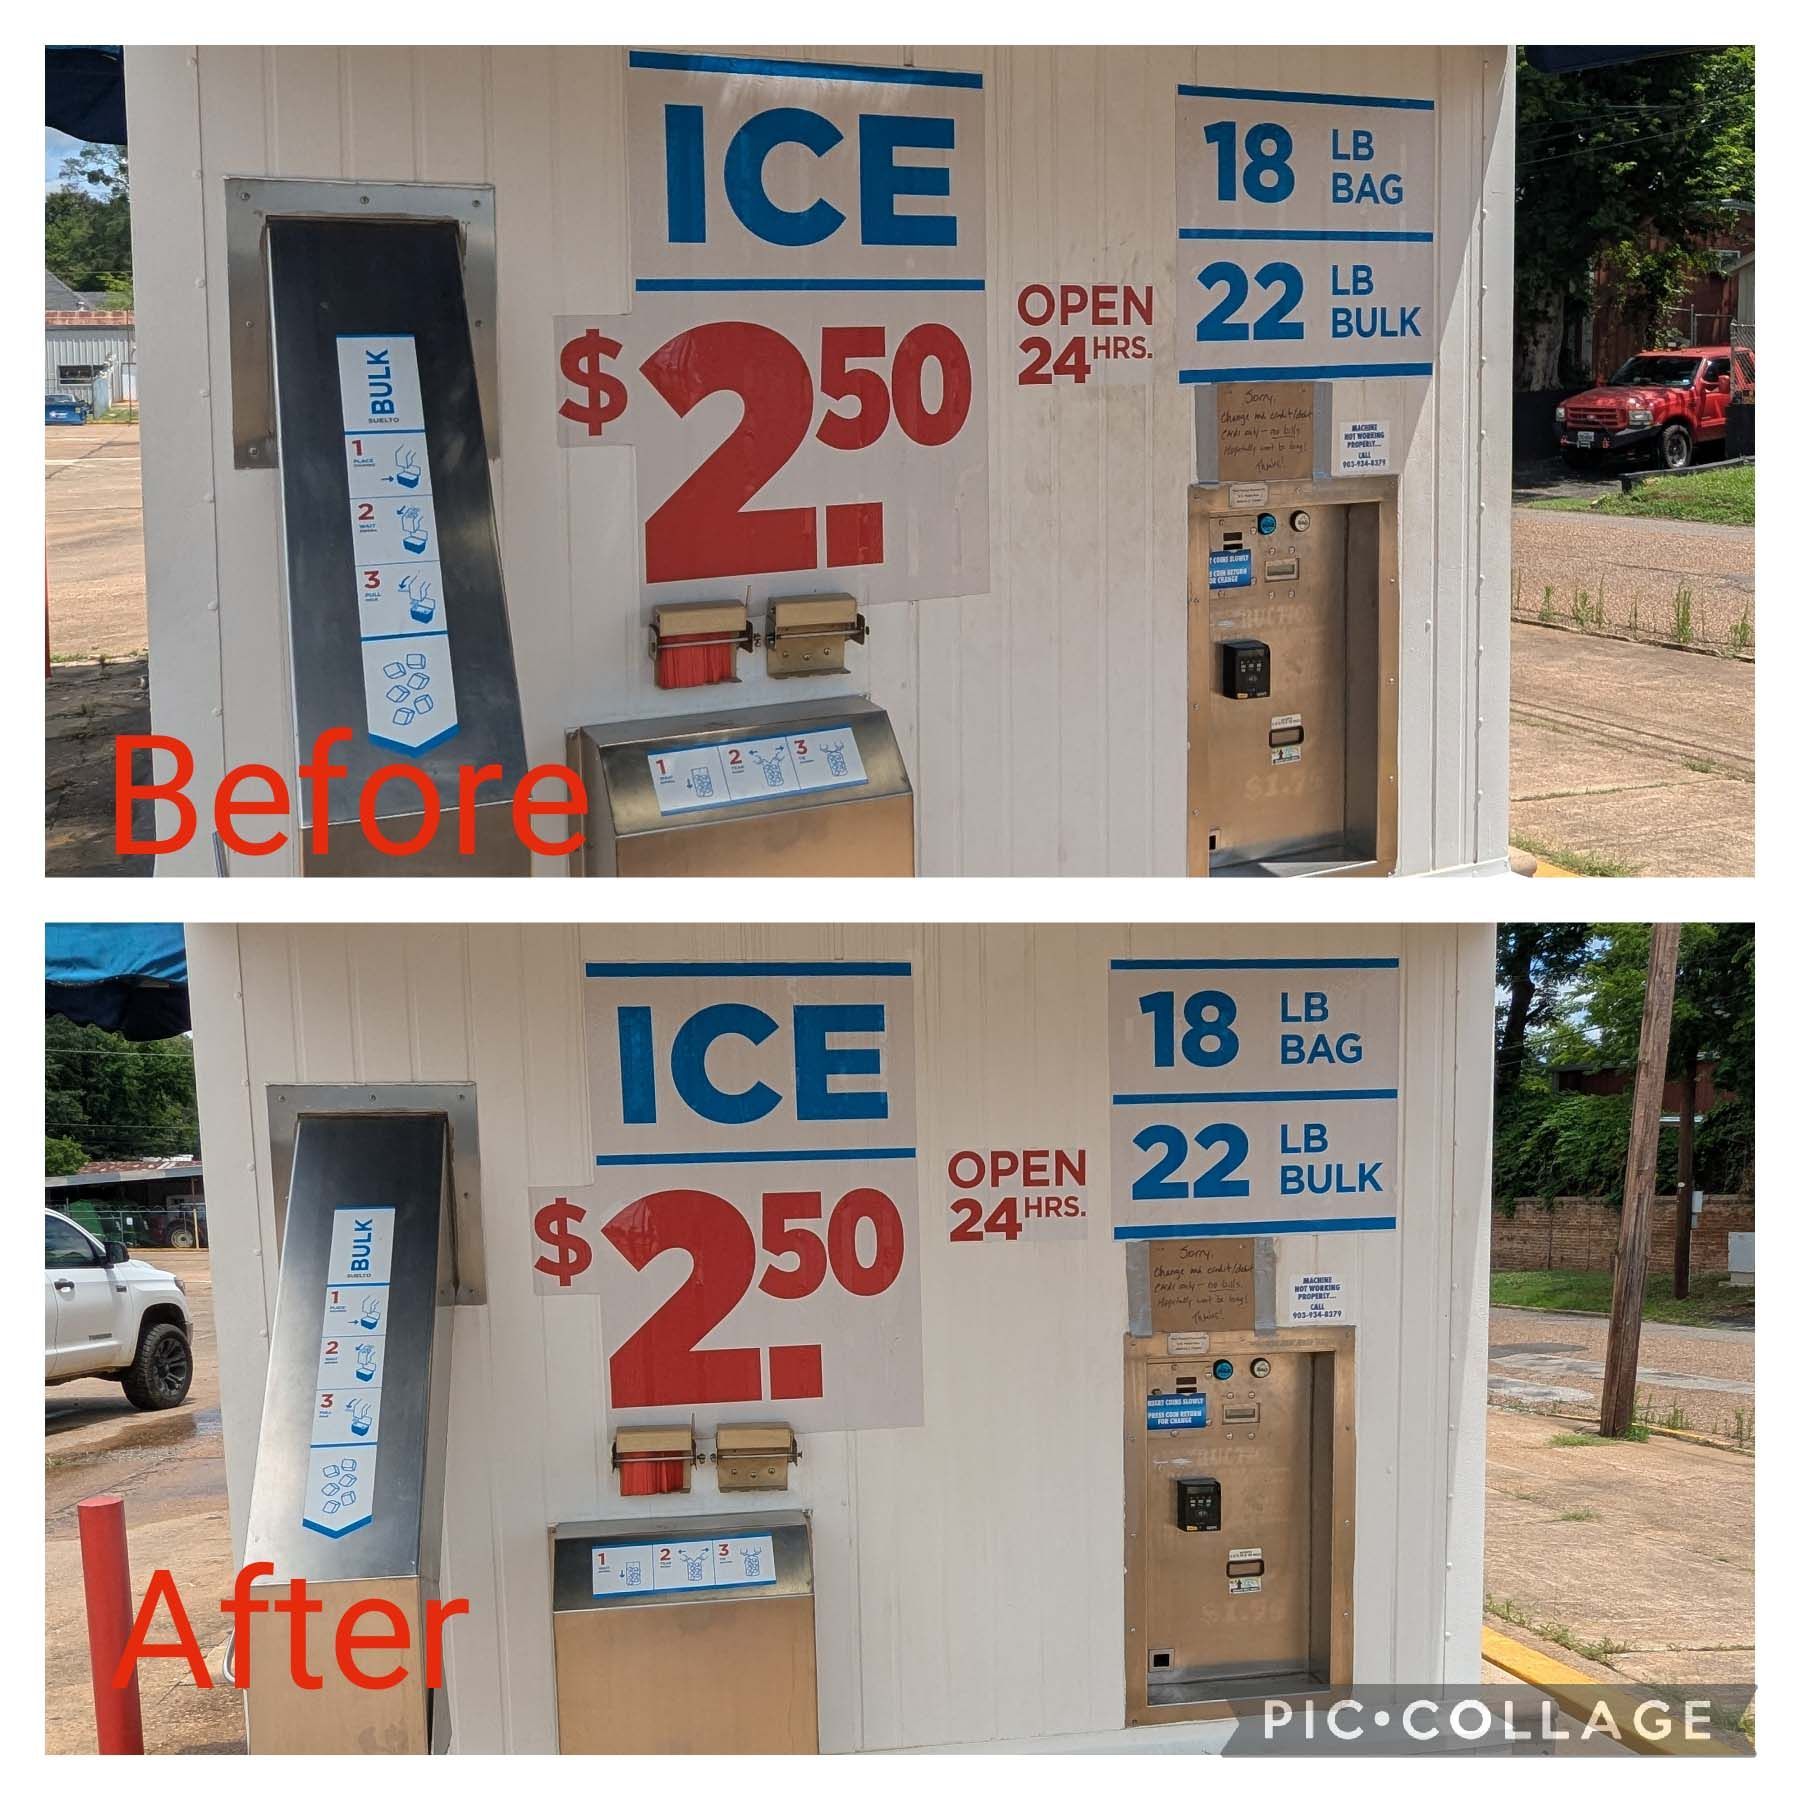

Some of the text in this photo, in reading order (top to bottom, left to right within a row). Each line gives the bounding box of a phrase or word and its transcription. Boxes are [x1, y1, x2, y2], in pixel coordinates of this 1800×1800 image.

[1331, 130, 1375, 160] LB
[1204, 122, 1296, 205] 18
[665, 105, 958, 247] ICE
[1331, 172, 1404, 206] BAG
[1330, 263, 1374, 296] LB
[1017, 283, 1154, 327] OPEN
[1195, 260, 1305, 343] 22
[1330, 306, 1422, 340] BULK
[1017, 335, 1153, 386] 24 HRS.
[366, 349, 395, 415] BULK
[1344, 432, 1384, 441] NOT WORKING
[1352, 424, 1378, 432] MACHINE
[351, 439, 364, 457] 1
[1358, 451, 1371, 460] CALL
[358, 503, 375, 521] 2
[364, 570, 381, 589] 3
[728, 749, 742, 765] 2
[794, 739, 807, 755] 3
[656, 759, 666, 775] 1
[1280, 992, 1329, 1024] LB
[1140, 991, 1239, 1068] 18
[1280, 1032, 1363, 1066] BAG
[618, 1004, 889, 1126] ICE
[1279, 1122, 1329, 1155] LB
[947, 1148, 1088, 1190] OPEN
[1131, 1123, 1251, 1201] 22
[1279, 1161, 1382, 1197] BULK
[948, 1195, 1087, 1243] 24 HRS.
[350, 1219, 374, 1271] BULK
[1179, 1245, 1214, 1259] Sorry,
[1153, 1265, 1185, 1279] Change
[1302, 1276, 1333, 1285] MACHINE
[331, 1291, 340, 1304] 1
[1294, 1284, 1341, 1293] NOT WORKING
[1310, 1303, 1325, 1311] CALL
[325, 1341, 339, 1355] 2
[320, 1394, 334, 1408] 3
[598, 1553, 605, 1565] 1
[660, 1548, 671, 1560] 2
[718, 1544, 729, 1556] 3
